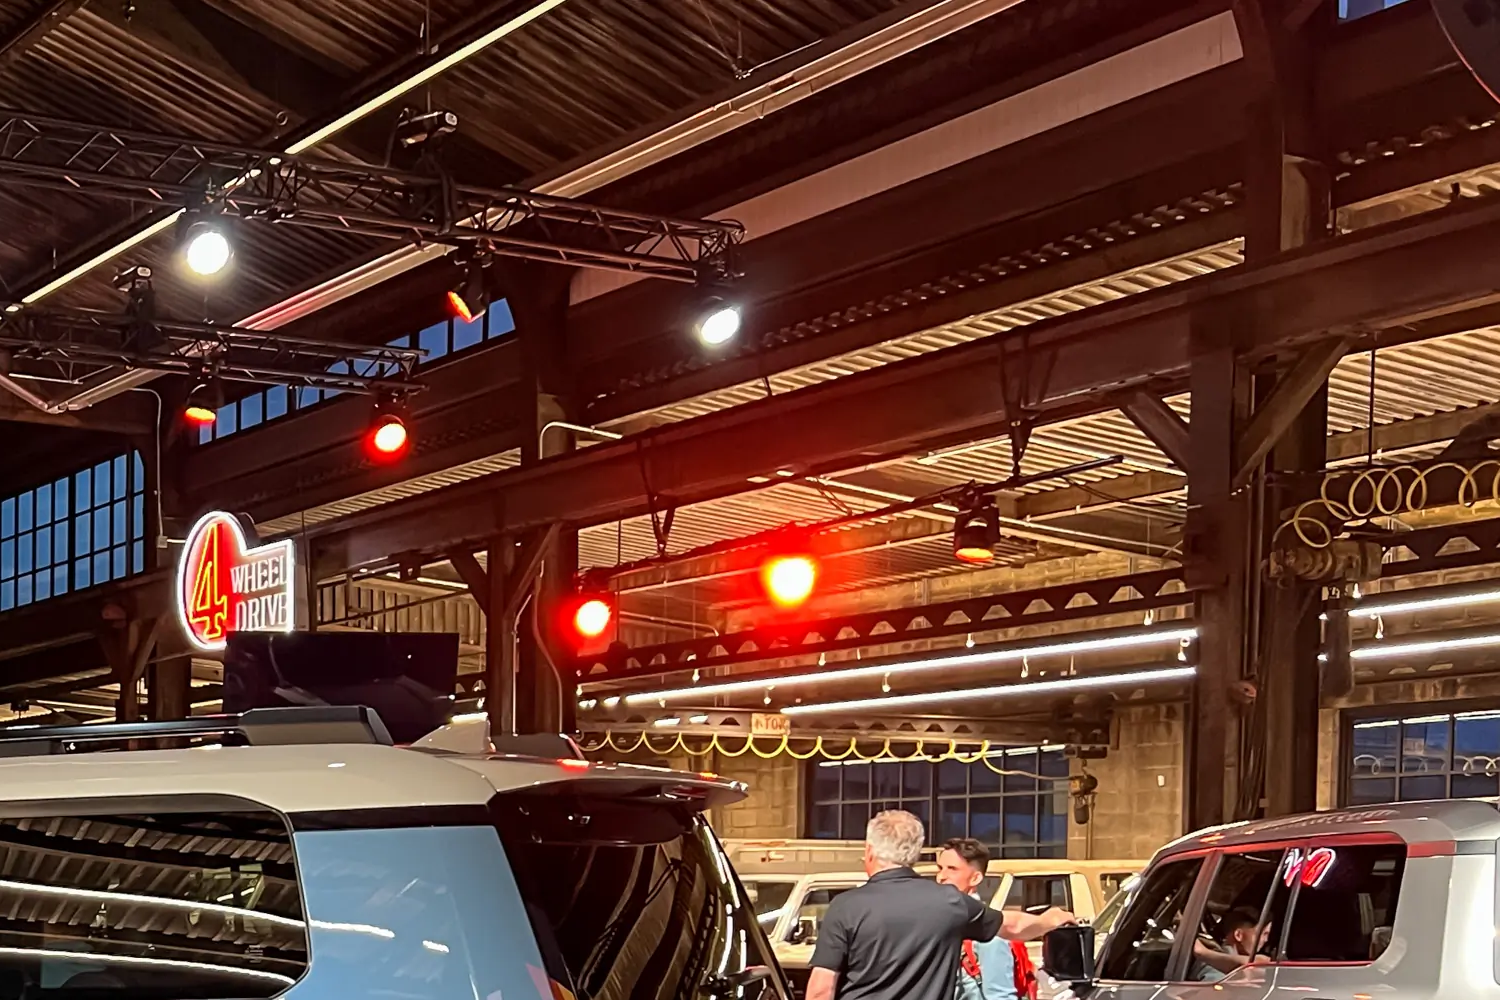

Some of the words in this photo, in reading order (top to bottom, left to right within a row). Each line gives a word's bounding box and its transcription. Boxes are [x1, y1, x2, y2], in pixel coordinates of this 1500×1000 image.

[190, 524, 227, 639] 4
[230, 555, 288, 594] WHEEL
[234, 591, 288, 632] DRIVE
